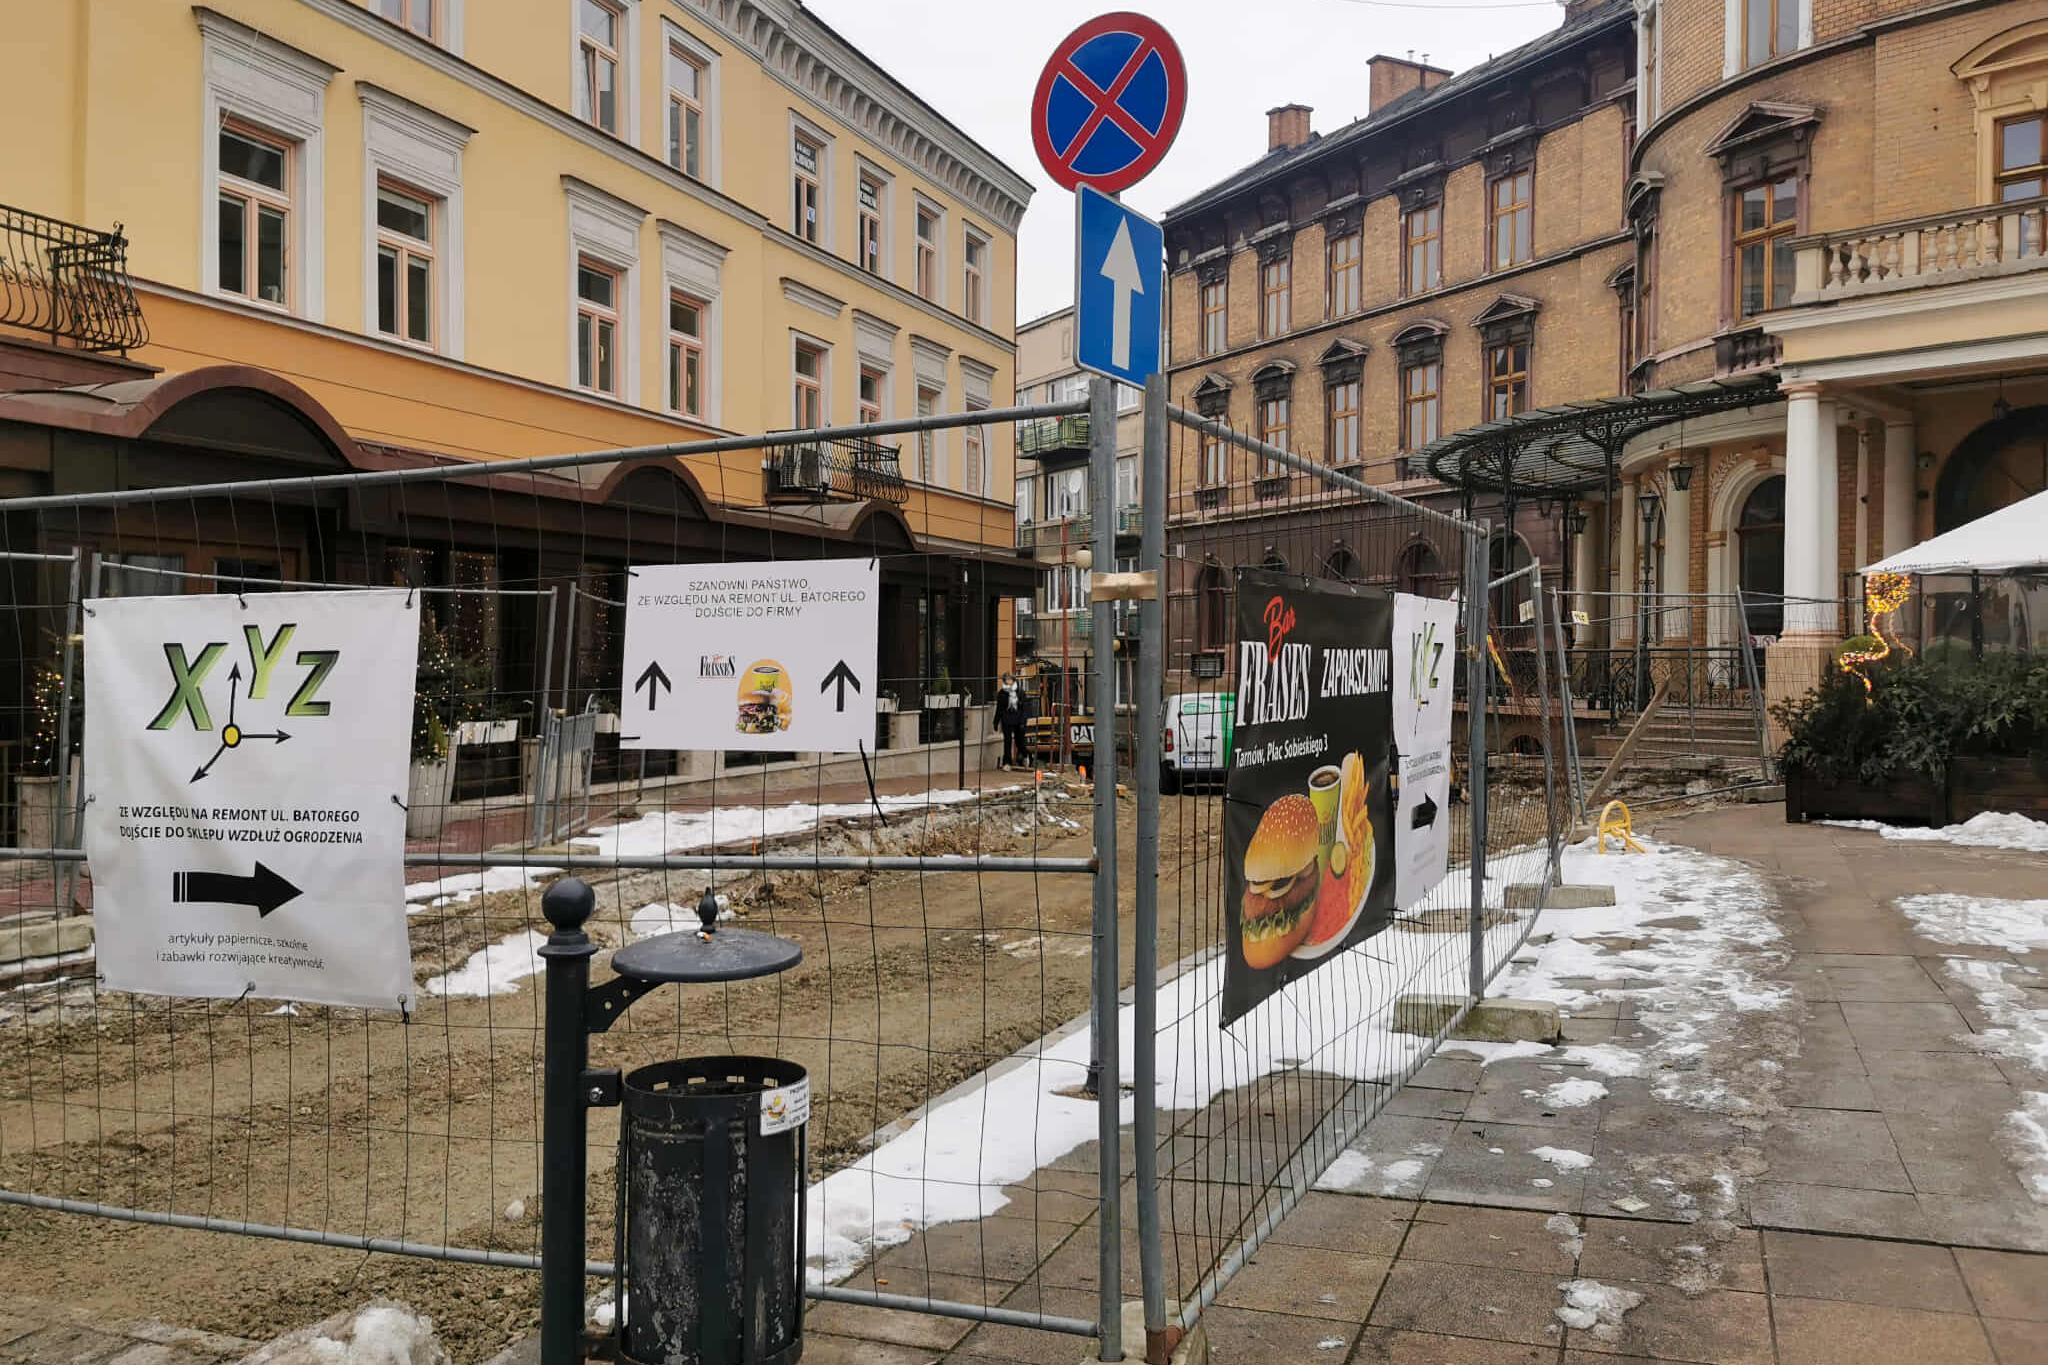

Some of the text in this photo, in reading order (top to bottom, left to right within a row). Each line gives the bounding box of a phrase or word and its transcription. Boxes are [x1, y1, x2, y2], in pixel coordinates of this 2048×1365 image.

[688, 581, 748, 591] SZANOWNI
[638, 596, 651, 606] ZE
[654, 594, 708, 606] WZGLĘDU
[711, 594, 726, 604] NA
[728, 592, 777, 604] REMONT
[801, 591, 866, 602] BATOREGO
[695, 606, 801, 618] DOJŚCIE DO FIRMY
[1263, 596, 1296, 662] Bar
[145, 622, 341, 732] XYZ
[1320, 648, 1389, 698] ZAPRASZAMY!
[1071, 725, 1096, 744] CAT
[1235, 743, 1266, 768] Tarnów,
[1284, 734, 1323, 759] Sobieskiego
[1323, 733, 1329, 752] 3
[119, 806, 360, 823] ZE WZGLĘDU NA REMONT UL. BATOREGO
[119, 824, 161, 840] DOJŚCIE
[165, 826, 185, 838] DO
[187, 826, 224, 841] SKLEPU
[283, 830, 363, 844] OGRODZENIA
[168, 932, 215, 947] artykuły
[161, 950, 206, 963] zabawki
[208, 952, 266, 966] rozwijające
